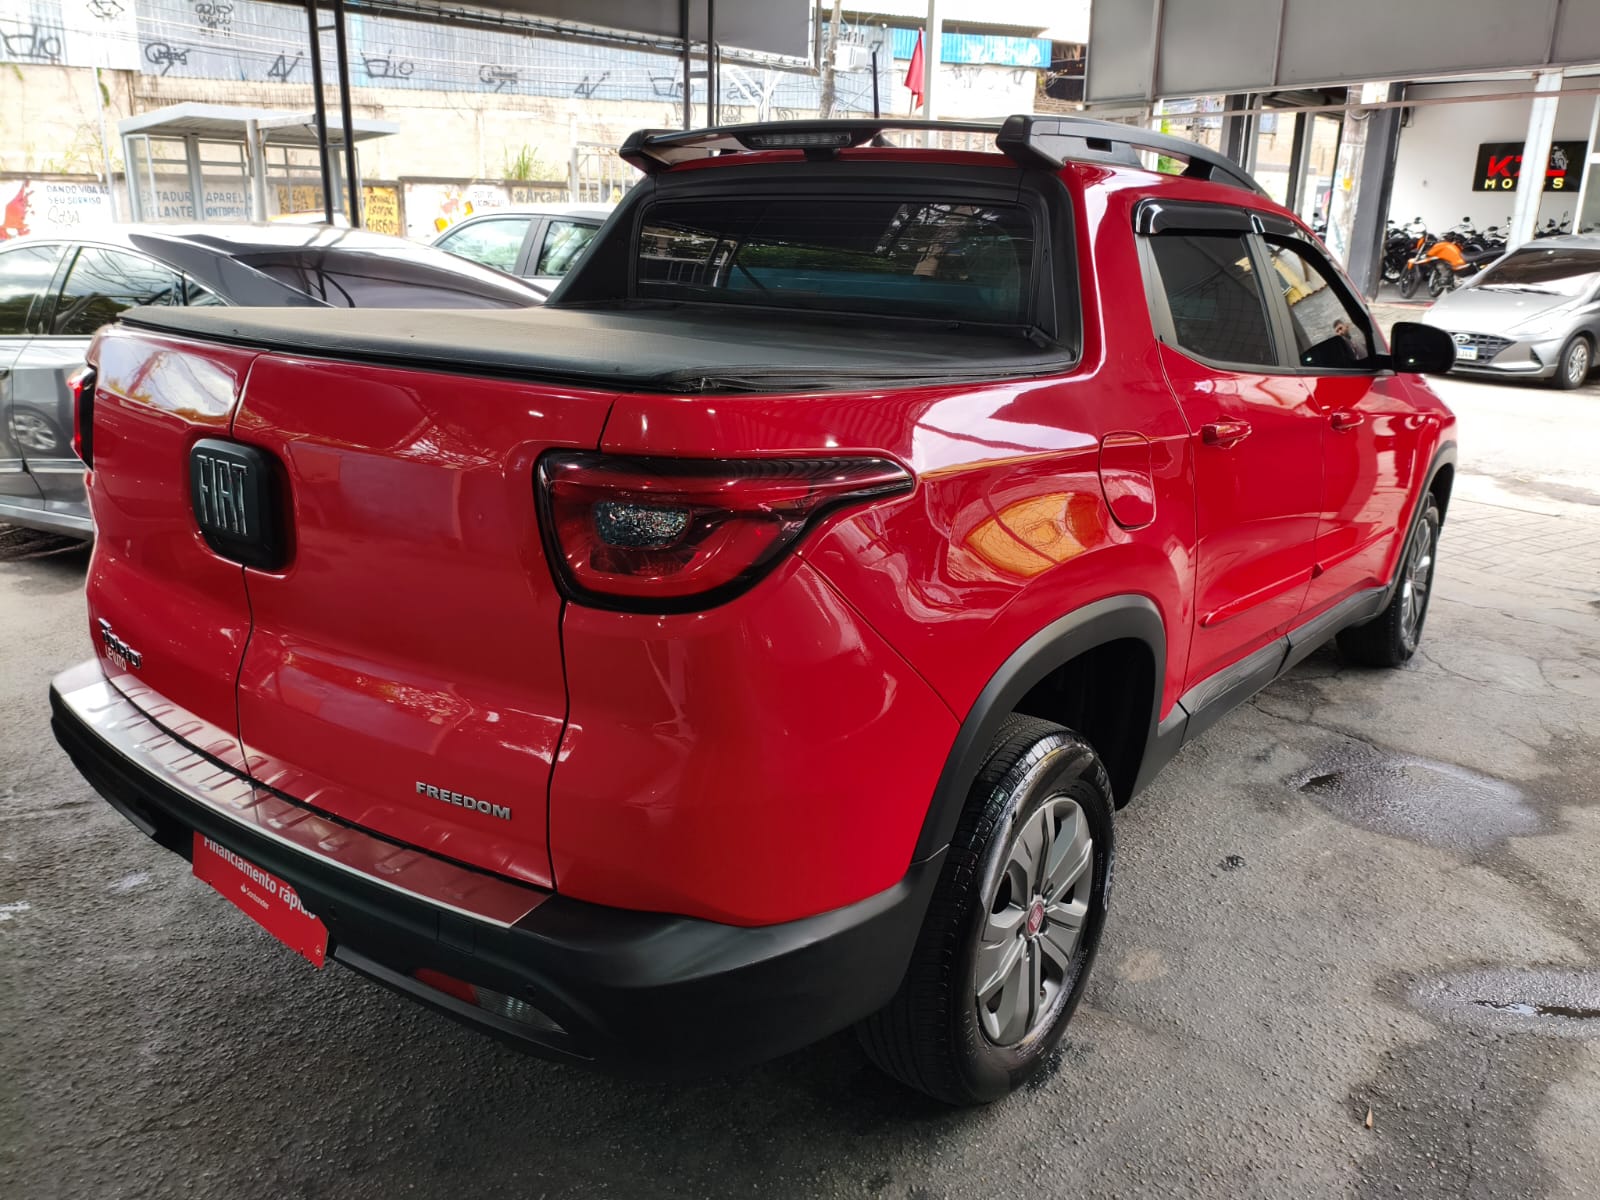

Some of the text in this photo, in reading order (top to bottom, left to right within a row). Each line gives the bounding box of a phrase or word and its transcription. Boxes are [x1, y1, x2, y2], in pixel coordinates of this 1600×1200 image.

[1483, 177, 1565, 190] MOS
[197, 454, 249, 537] FIAT
[415, 781, 511, 821] FREEDOM
[203, 836, 277, 894] Financiamento
